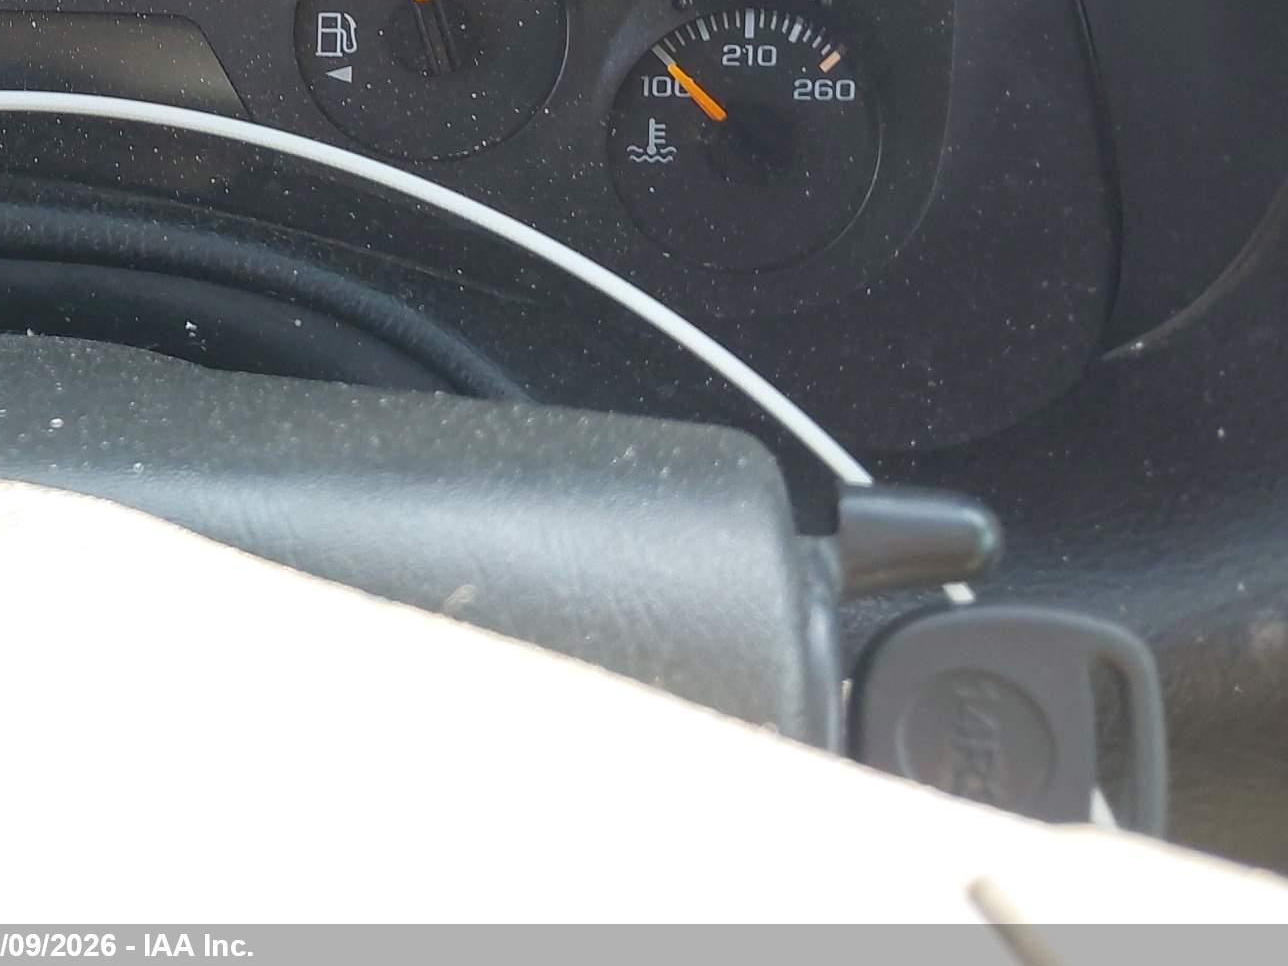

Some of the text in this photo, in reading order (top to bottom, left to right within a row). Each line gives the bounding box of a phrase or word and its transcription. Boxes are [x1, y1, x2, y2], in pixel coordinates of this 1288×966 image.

[721, 44, 778, 67] 210
[640, 75, 693, 98] 100
[793, 78, 856, 101] 260
